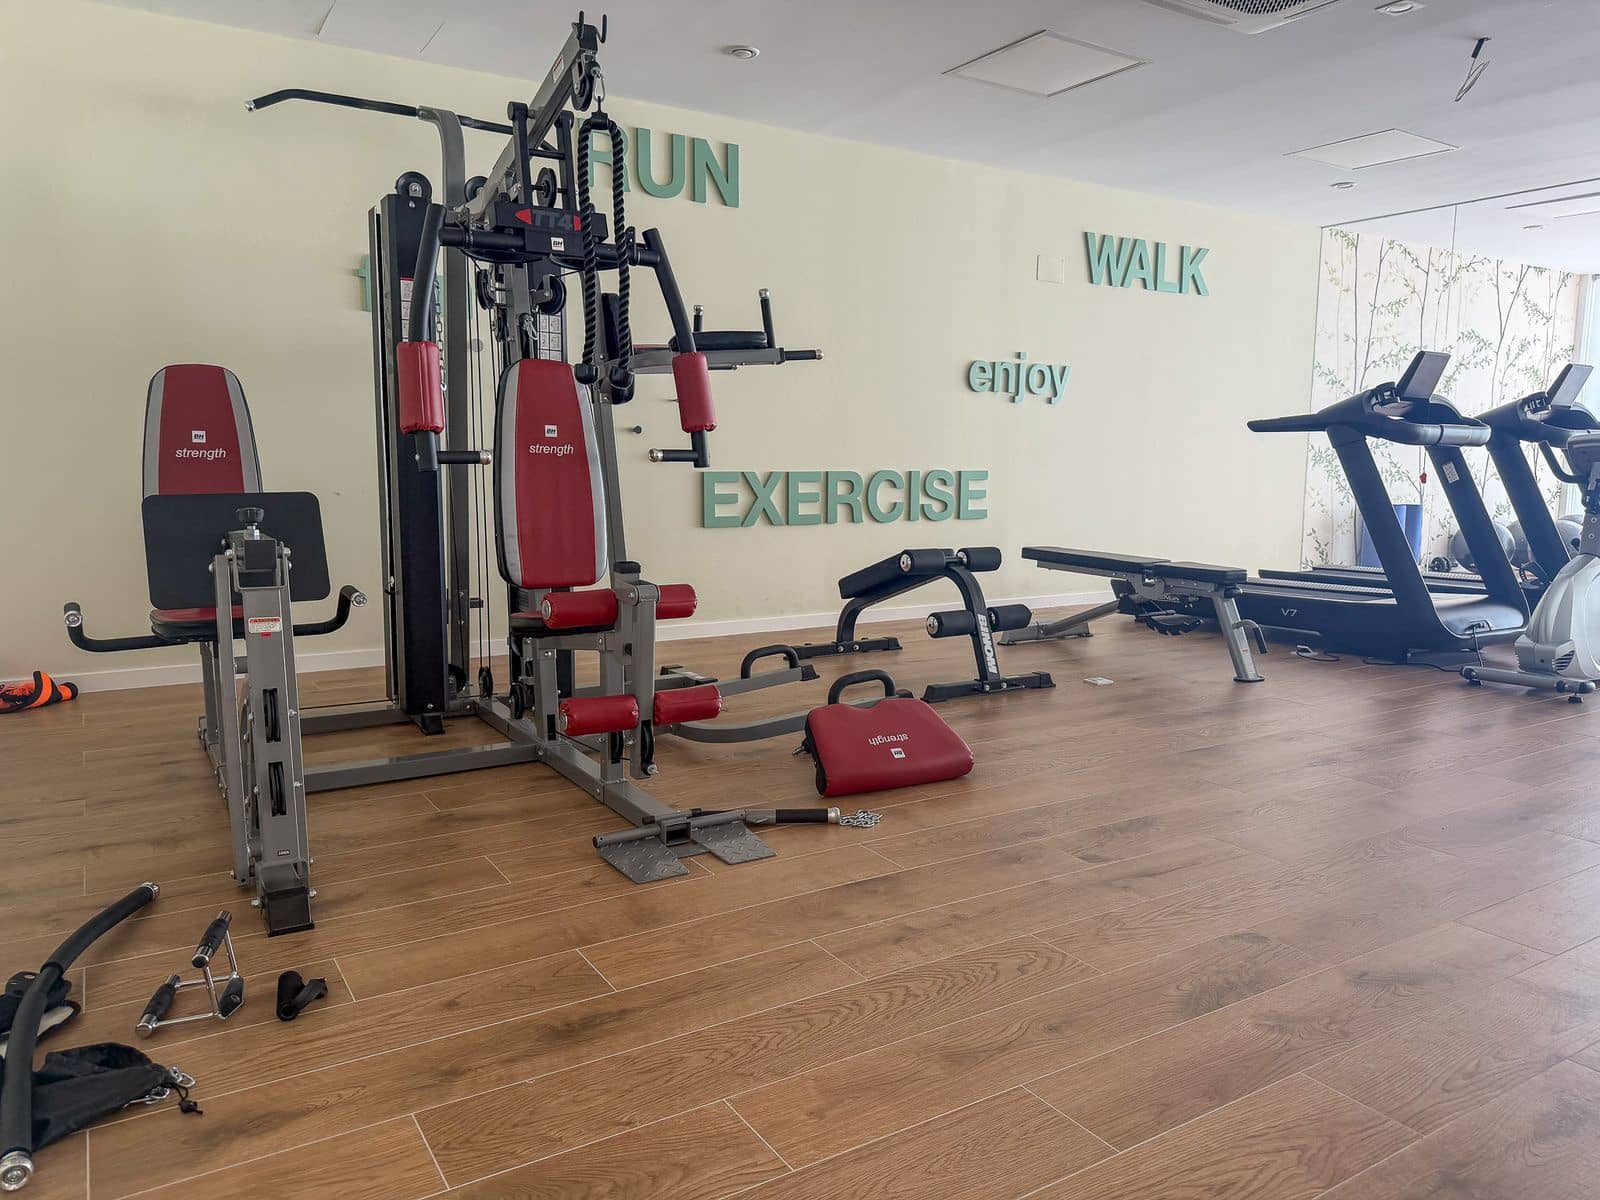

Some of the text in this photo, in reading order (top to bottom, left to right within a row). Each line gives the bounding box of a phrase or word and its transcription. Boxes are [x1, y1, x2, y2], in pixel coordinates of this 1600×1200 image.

[1083, 231, 1210, 297] WALK
[967, 351, 1072, 405] enjoy
[175, 448, 226, 461] strength
[529, 443, 574, 457] strength
[700, 469, 989, 528] EXERCISE
[1281, 607, 1297, 617] V7
[867, 733, 909, 746] strength
